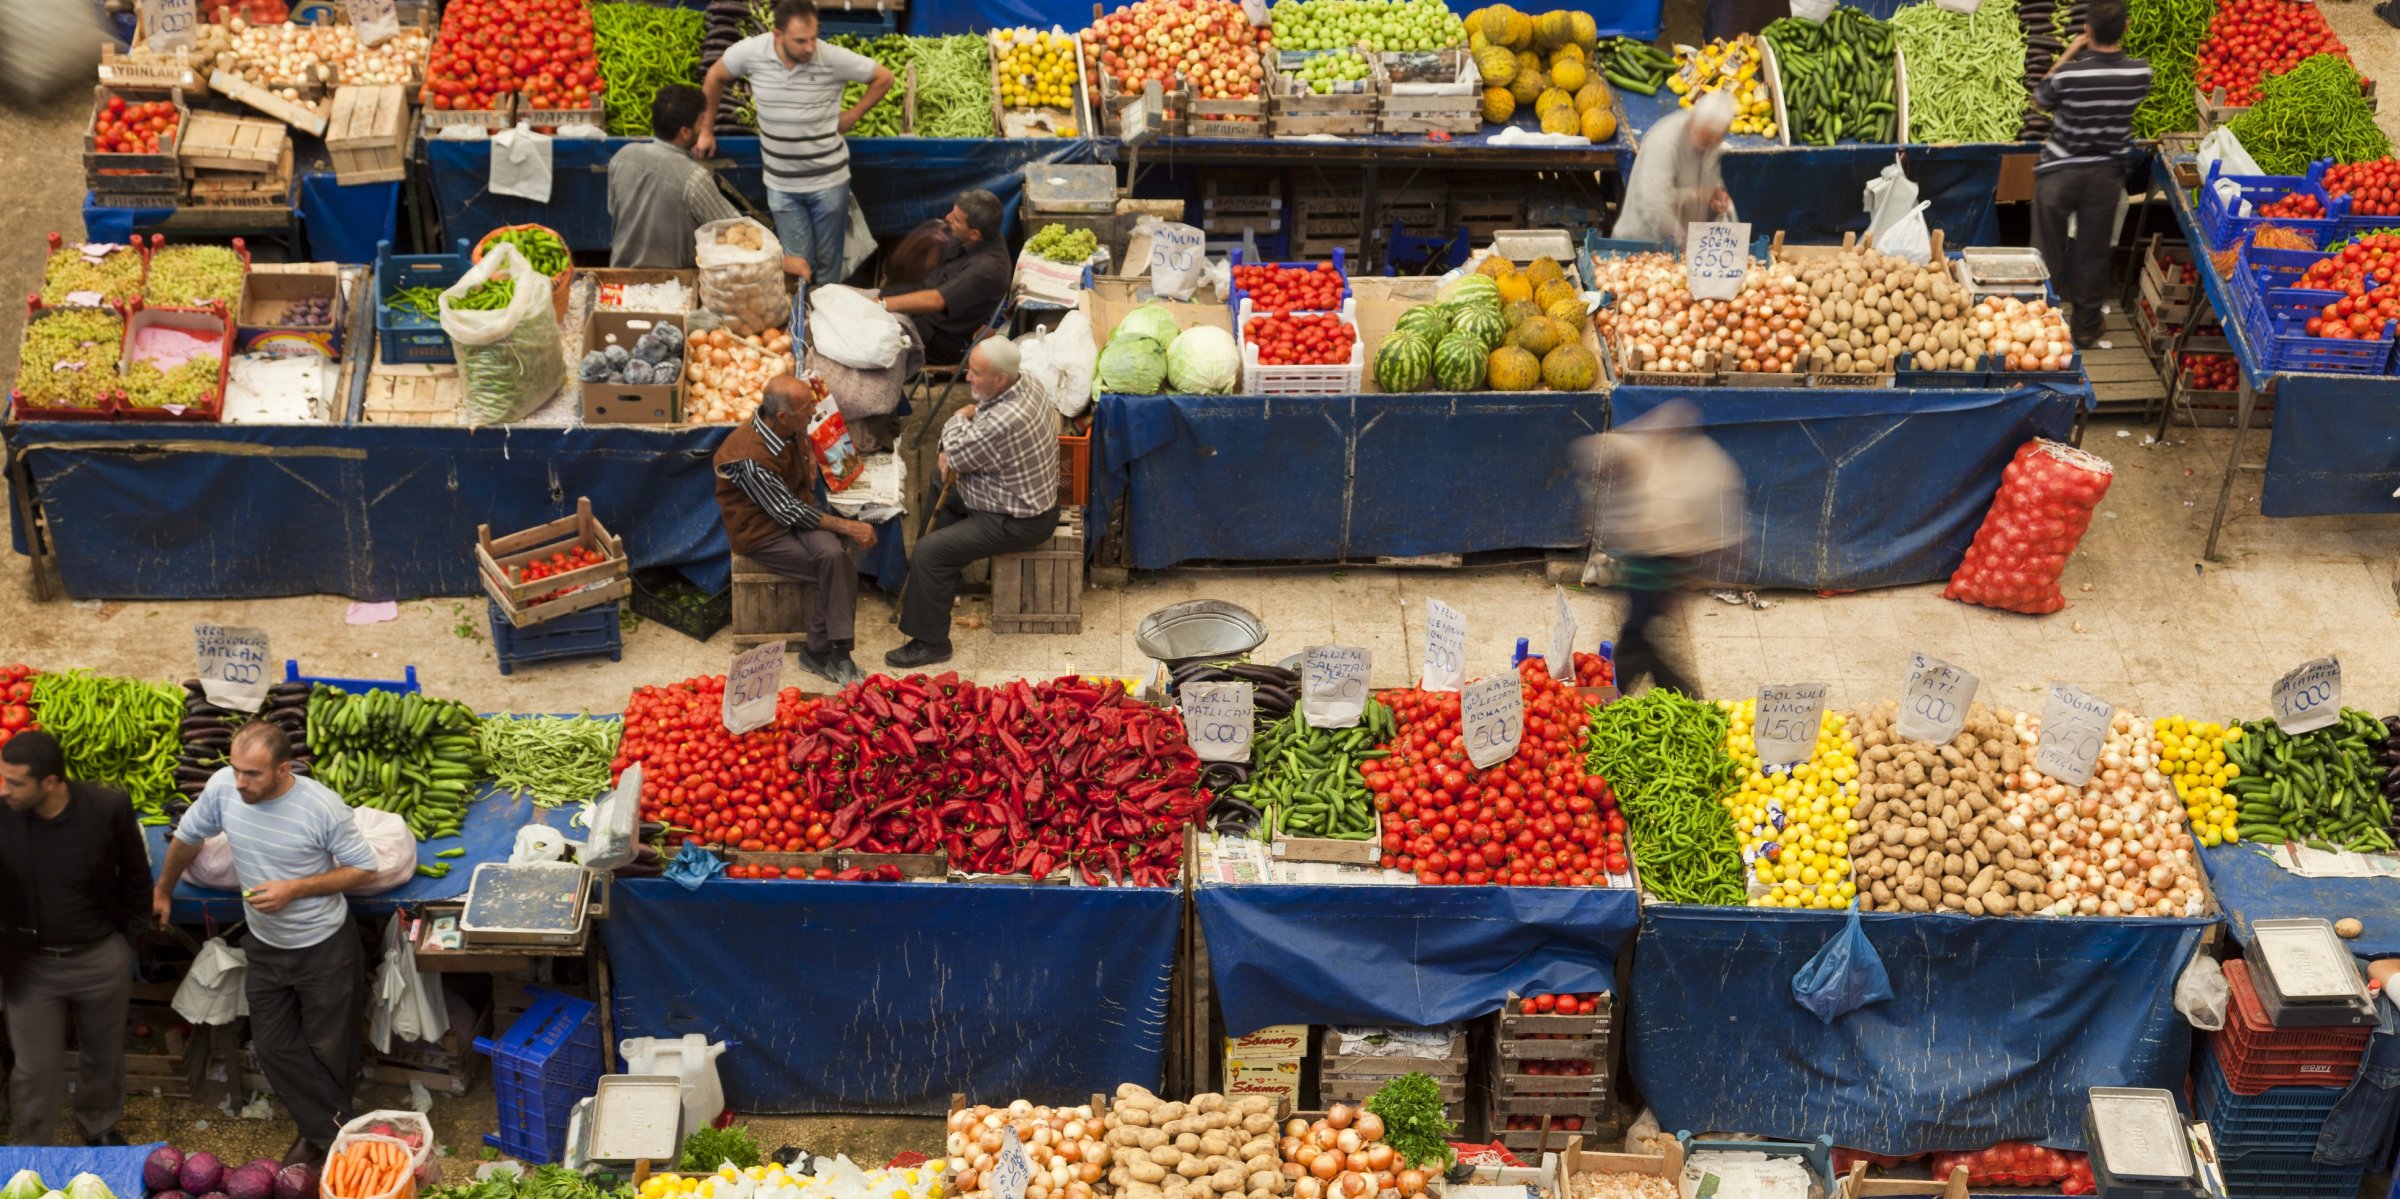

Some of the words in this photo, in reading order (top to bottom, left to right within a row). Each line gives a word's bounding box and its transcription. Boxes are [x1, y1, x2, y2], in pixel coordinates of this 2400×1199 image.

[1151, 243, 1193, 272] 500
[1694, 247, 1734, 269] 650
[1426, 643, 1457, 673] 500
[731, 673, 773, 707] 500
[1762, 689, 1792, 701] BOL
[1473, 715, 1519, 750] 500
